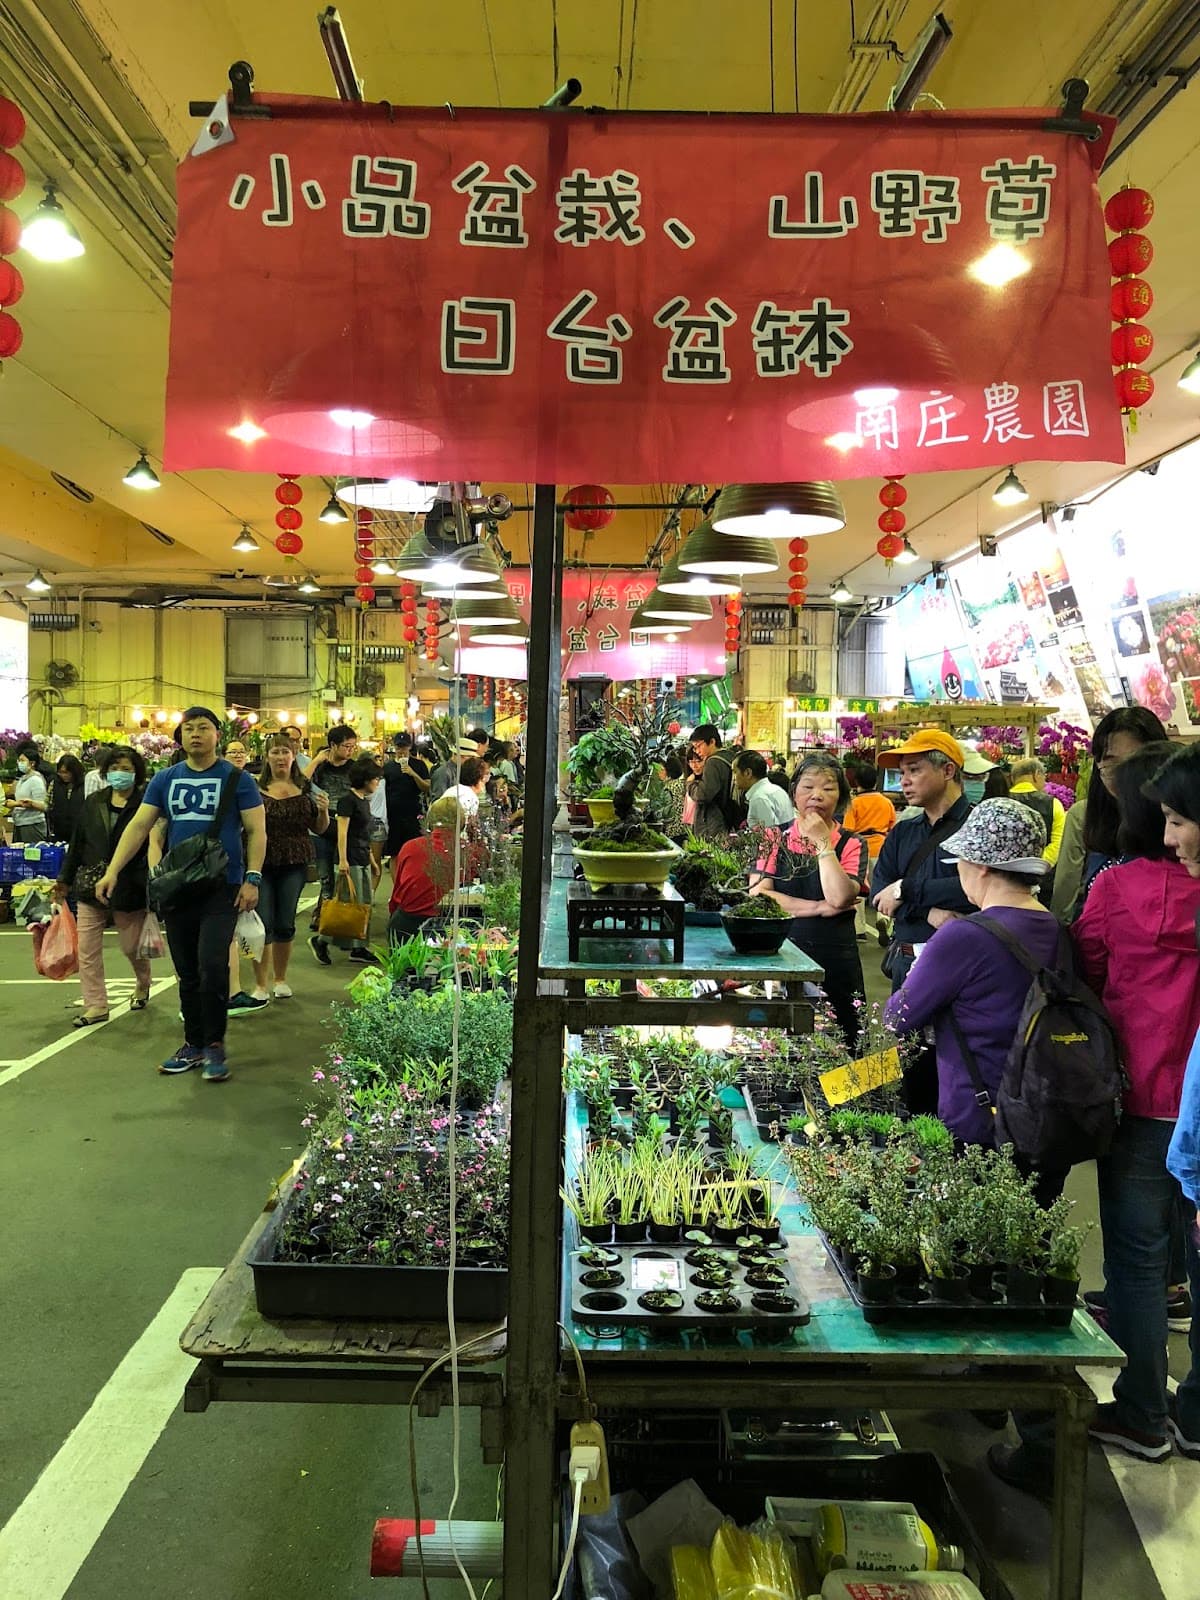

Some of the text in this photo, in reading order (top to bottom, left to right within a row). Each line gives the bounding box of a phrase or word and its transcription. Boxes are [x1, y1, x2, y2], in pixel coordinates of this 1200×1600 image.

[441, 289, 854, 384] 日台盆鉢
[854, 379, 1090, 451] 南庄農園
